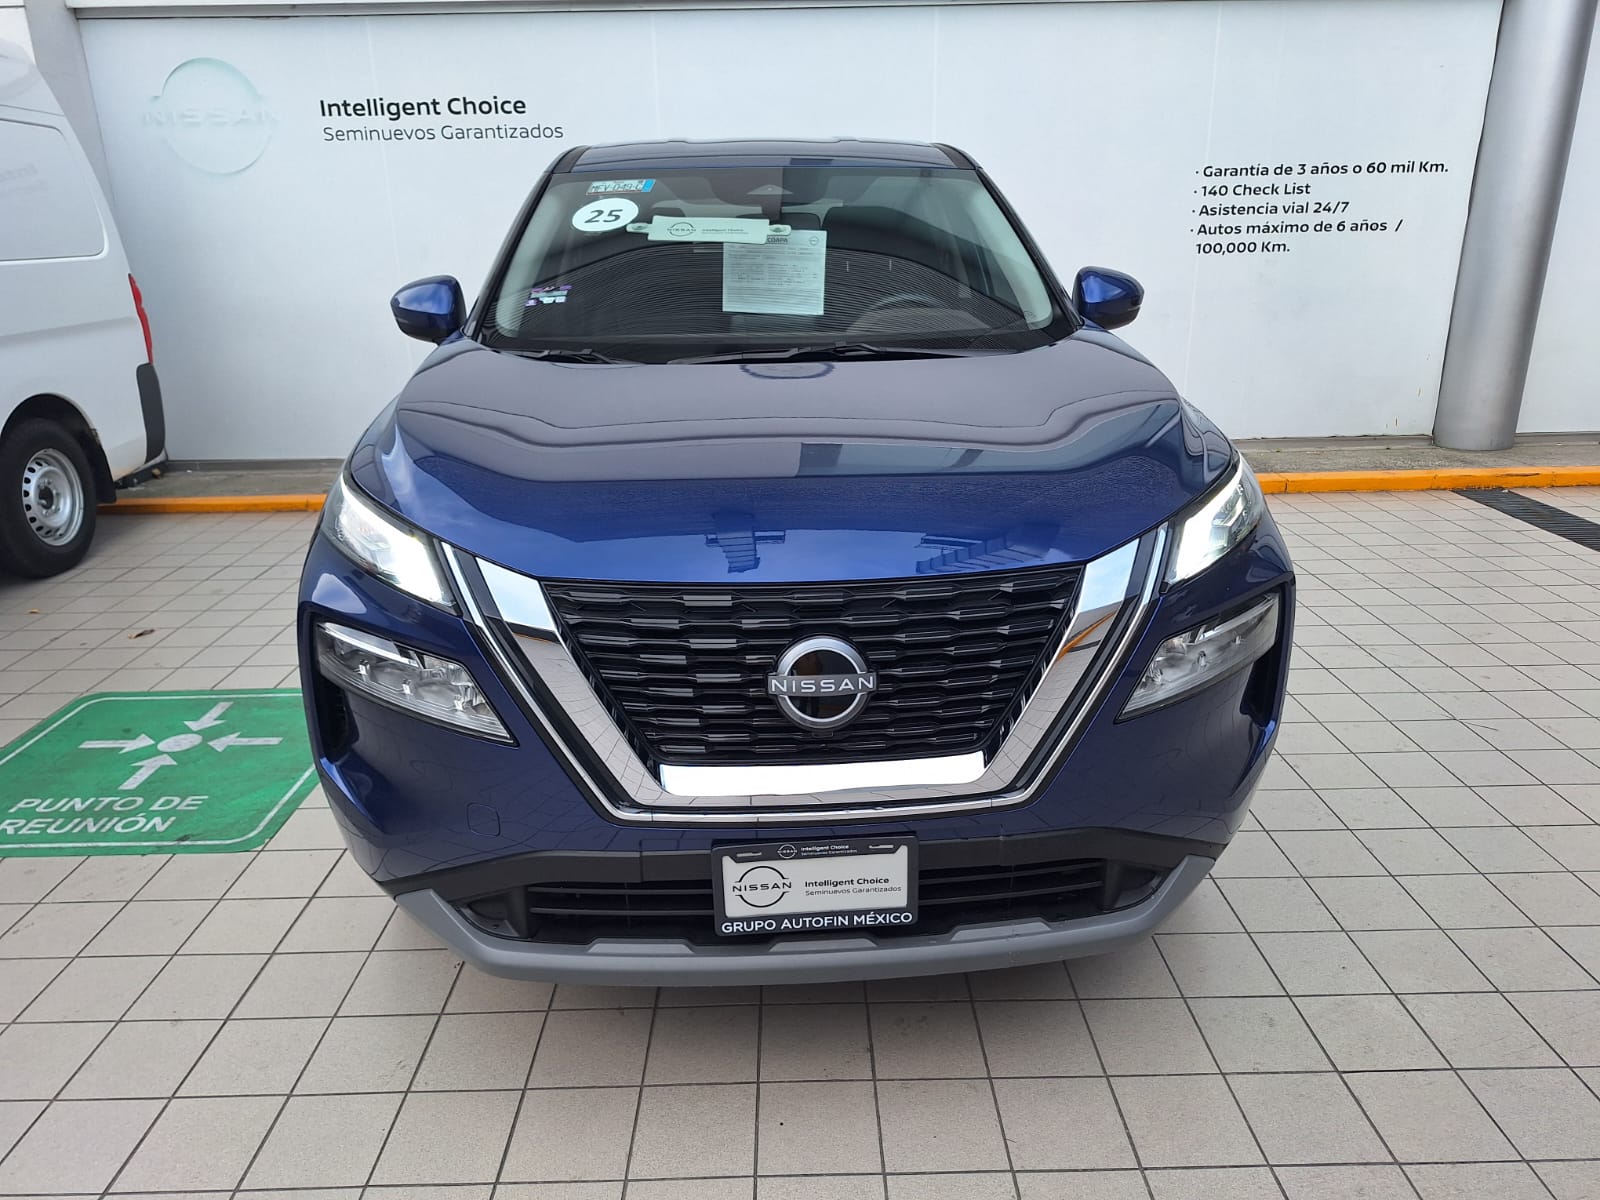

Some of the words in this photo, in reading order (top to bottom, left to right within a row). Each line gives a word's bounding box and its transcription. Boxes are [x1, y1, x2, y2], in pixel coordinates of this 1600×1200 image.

[320, 97, 441, 121] Intelligent
[447, 96, 526, 115] Choice
[142, 108, 277, 127] NISSAN
[323, 126, 435, 141] Seminuevos
[441, 123, 564, 140] Garantizados
[1274, 164, 1293, 176] de
[1297, 164, 1306, 175] 3
[1310, 162, 1348, 174] años
[1353, 165, 1362, 174] o
[1367, 162, 1387, 173] 60
[1391, 161, 1415, 173] mil
[1420, 161, 1448, 173] Km.
[1202, 185, 1228, 197] 140
[1233, 183, 1280, 196] Check
[1284, 182, 1311, 195] List
[584, 209, 623, 223] 25
[1199, 202, 1278, 216] Asistencia
[1283, 201, 1309, 214] vial
[1313, 201, 1350, 214] 24/7
[1197, 224, 1242, 235] Autos
[1246, 221, 1309, 234] máximo
[1314, 220, 1332, 232] de
[1337, 221, 1346, 232] 6
[1350, 219, 1387, 231] años
[1196, 242, 1257, 255] 100,000
[1261, 241, 1290, 252] Km.
[772, 676, 873, 693] NISSAN
[8, 797, 144, 813] PUNTO
[149, 796, 208, 810] DE
[0, 813, 176, 834] REUNIÓN
[732, 882, 792, 892] NISSAN
[805, 879, 854, 888] Intelligent
[857, 878, 889, 886] Choice
[721, 920, 776, 933] GRUPO
[781, 915, 848, 930] AUTOFIN
[854, 911, 912, 926] MÉXICO
